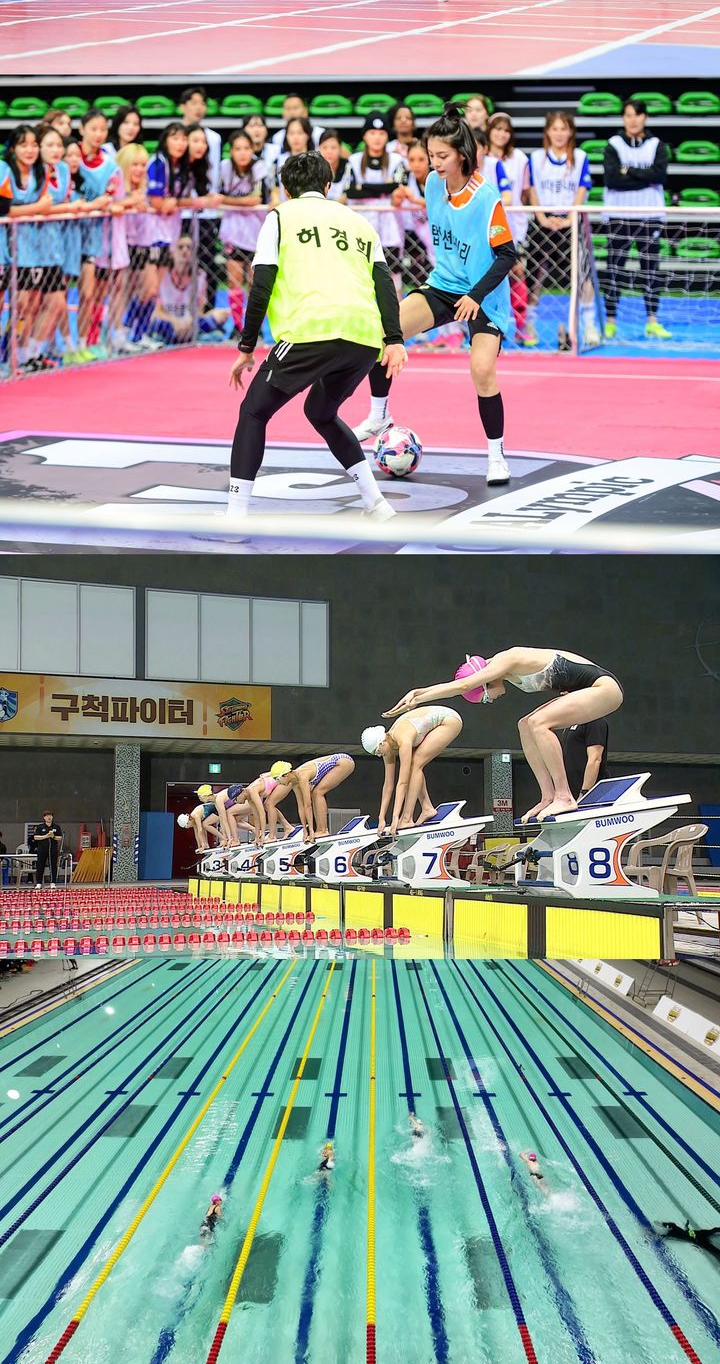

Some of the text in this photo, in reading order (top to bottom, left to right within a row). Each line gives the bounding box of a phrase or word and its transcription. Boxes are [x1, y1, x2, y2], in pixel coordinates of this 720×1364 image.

[297, 226, 372, 263] 허경희
[51, 693, 194, 726] 구척파이터
[497, 799, 508, 807] 3M
[595, 814, 635, 828] BUMWOO
[426, 830, 455, 840] BUMWOO
[212, 859, 221, 871] 3
[241, 858, 250, 872] 4
[279, 857, 290, 872] 5
[334, 855, 347, 874] 6
[422, 852, 438, 875] 7
[588, 847, 612, 879] 8
